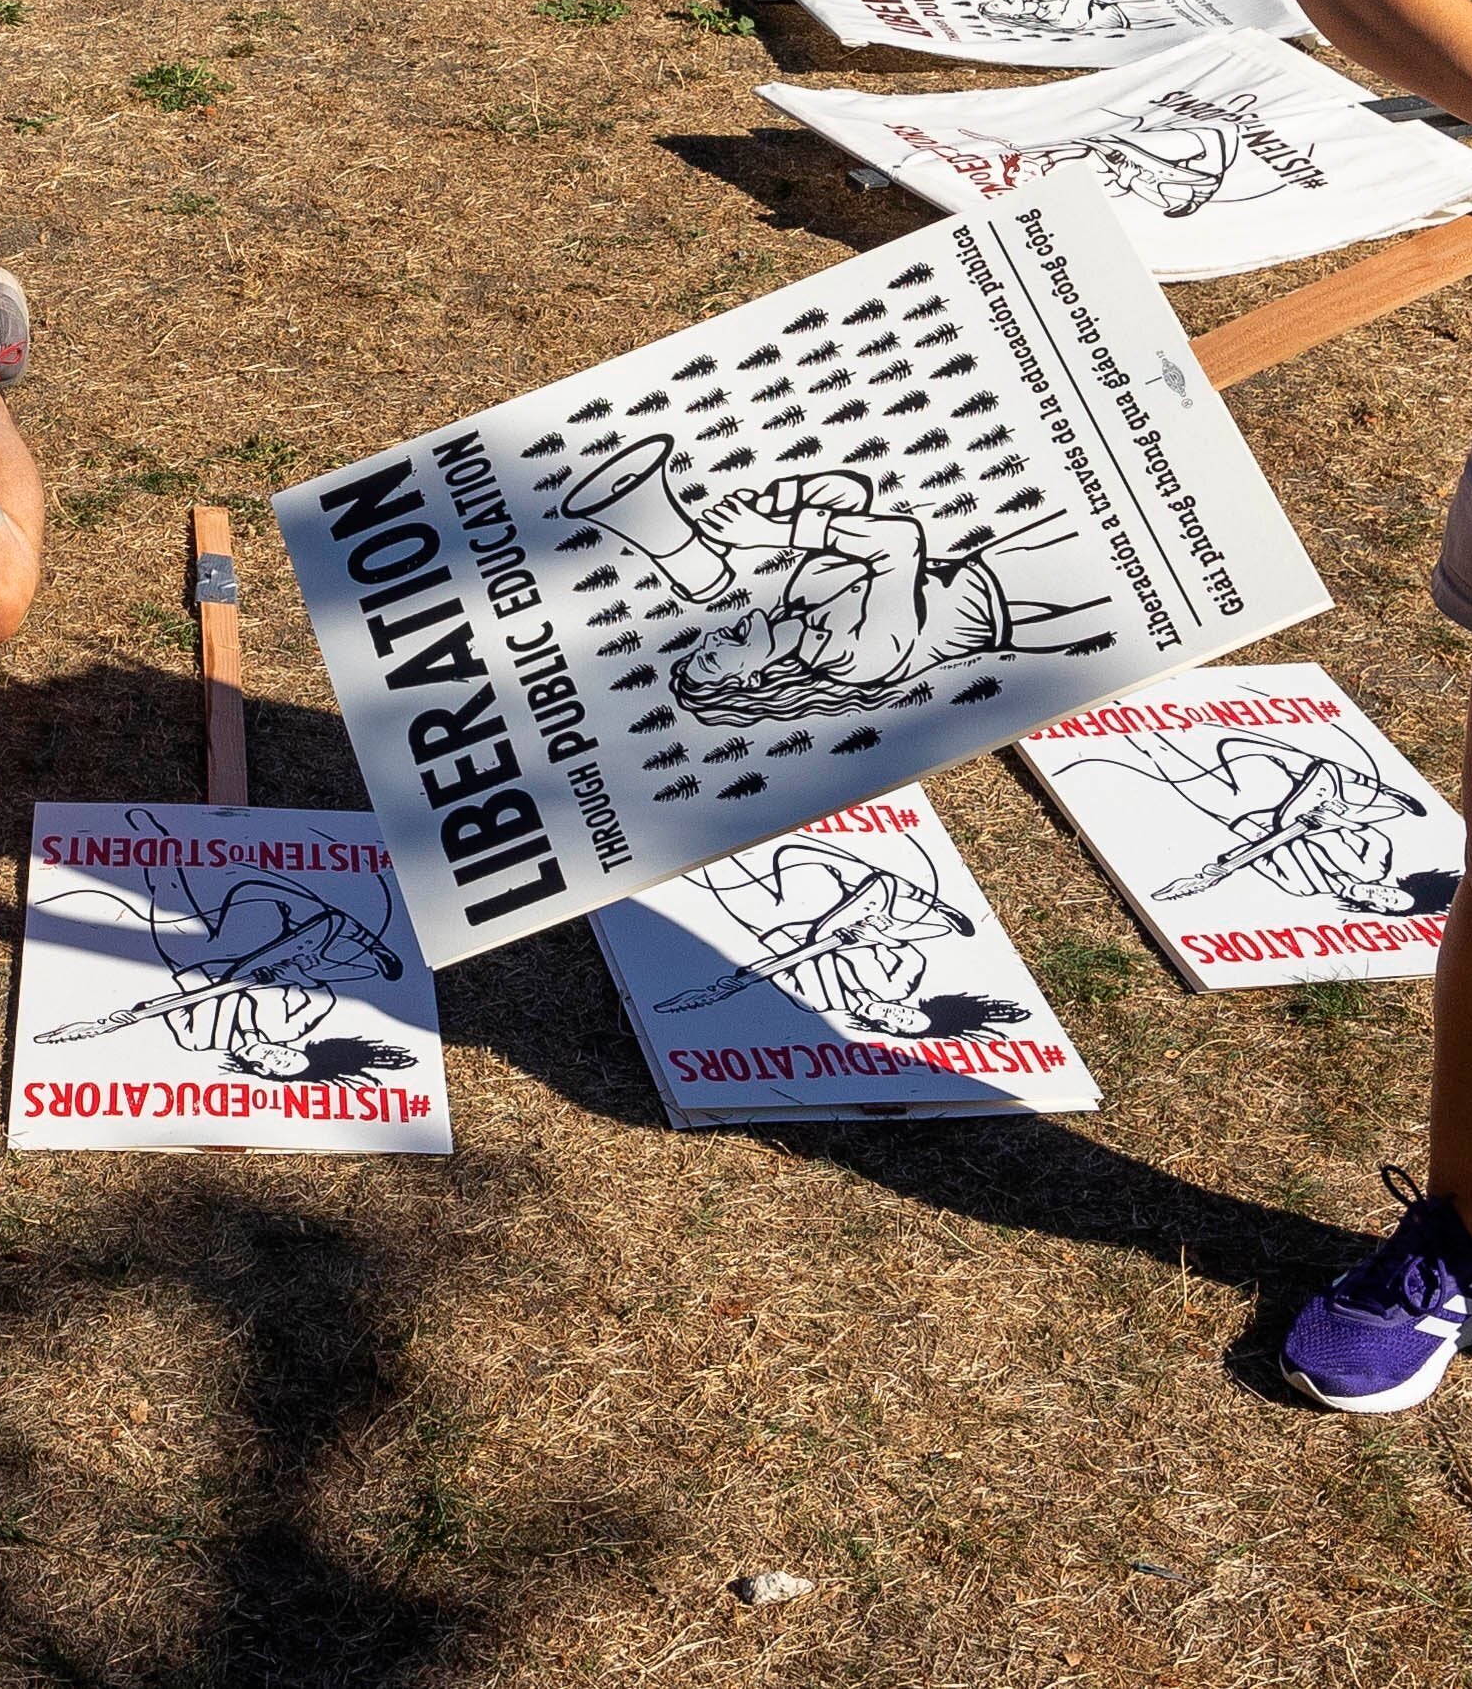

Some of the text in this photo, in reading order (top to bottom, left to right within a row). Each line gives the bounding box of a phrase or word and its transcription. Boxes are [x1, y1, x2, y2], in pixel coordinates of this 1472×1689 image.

[1015, 208, 1056, 257] cộng
[1041, 255, 1079, 307] công
[1091, 346, 1131, 391] giáo
[951, 224, 1182, 652] Liberación a través de la educación pública
[1115, 392, 1150, 432] qua
[1134, 429, 1182, 498] thông
[1167, 494, 1225, 569] phóng
[432, 430, 633, 874] THROUGH PUBLIC EDUCATION
[319, 454, 569, 928] LIBERATION
[671, 1039, 1066, 1084] #LISTENTOEDUCATORS
[24, 1082, 431, 1123] #LISTENTOEDUCATORS
